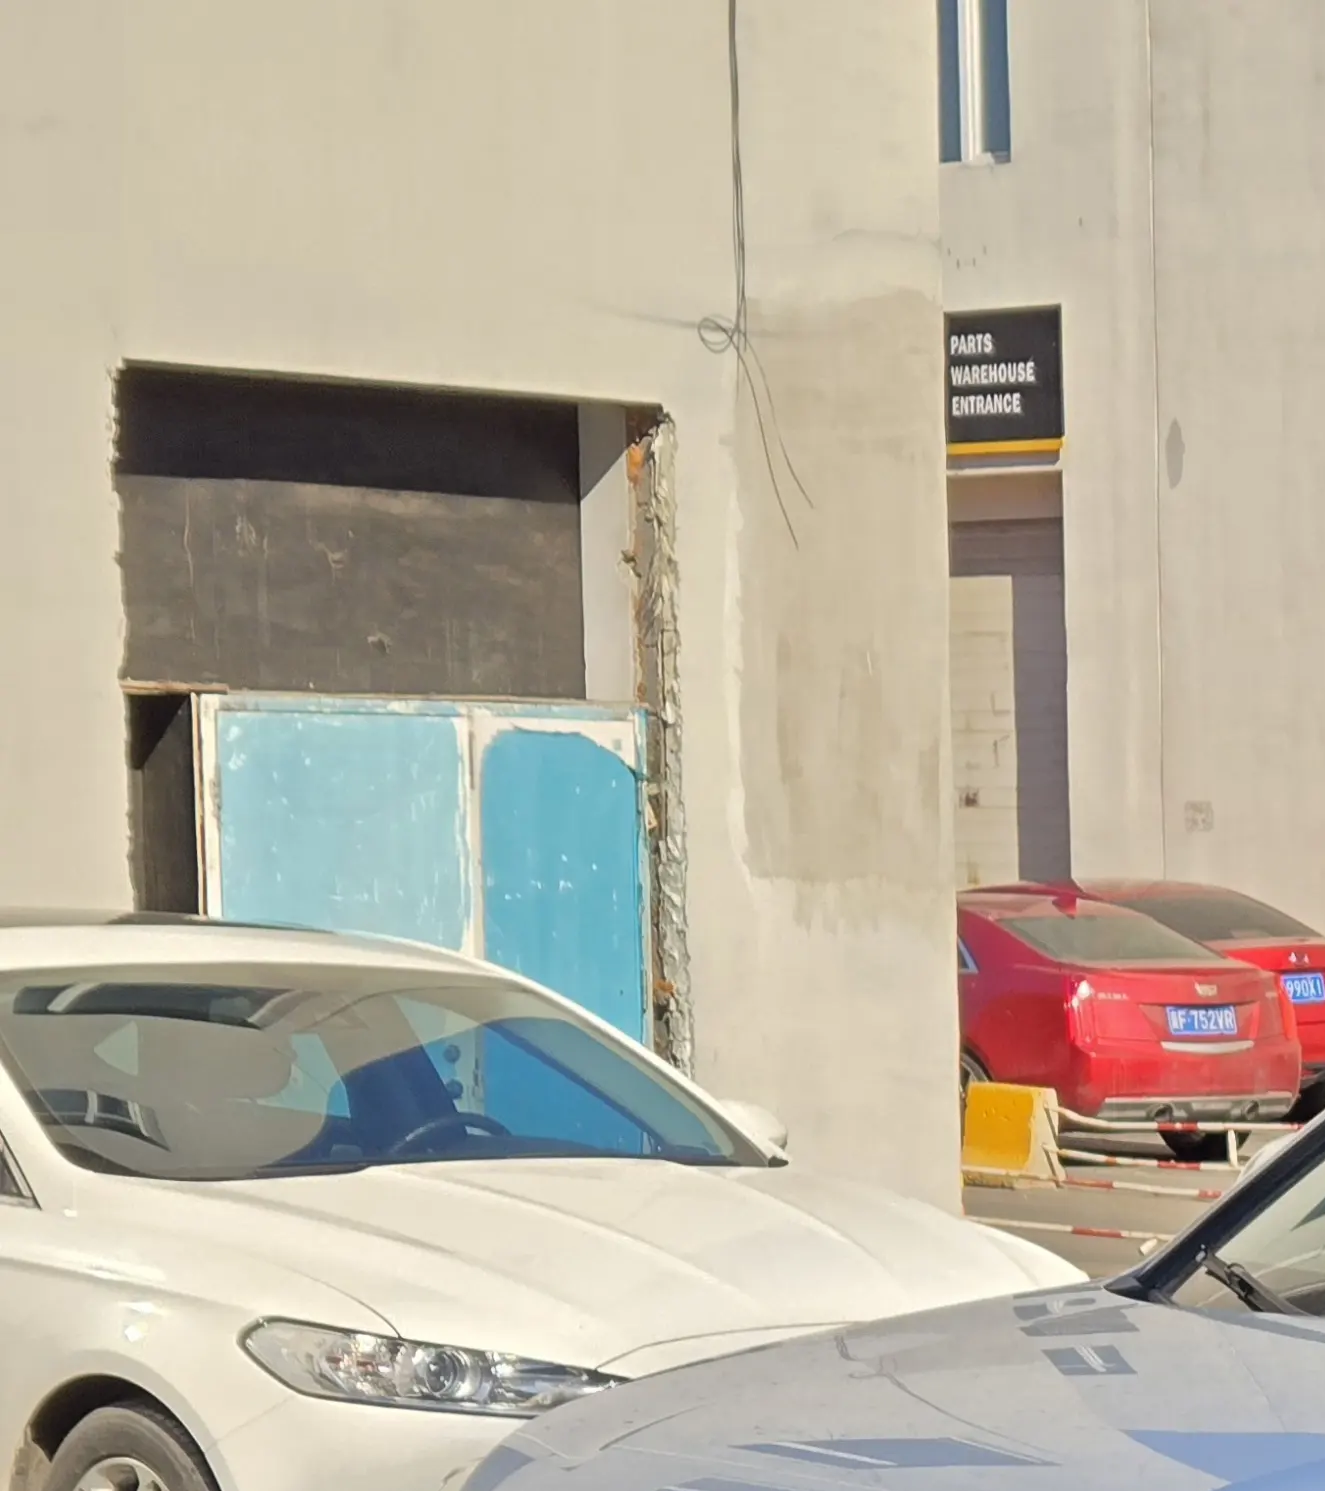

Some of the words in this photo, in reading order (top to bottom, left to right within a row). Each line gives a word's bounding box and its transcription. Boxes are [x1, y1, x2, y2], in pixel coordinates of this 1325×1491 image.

[950, 332, 994, 355] PARTS
[950, 360, 1036, 386] WAREHOUSE
[951, 392, 1022, 417] ENTRANCE
